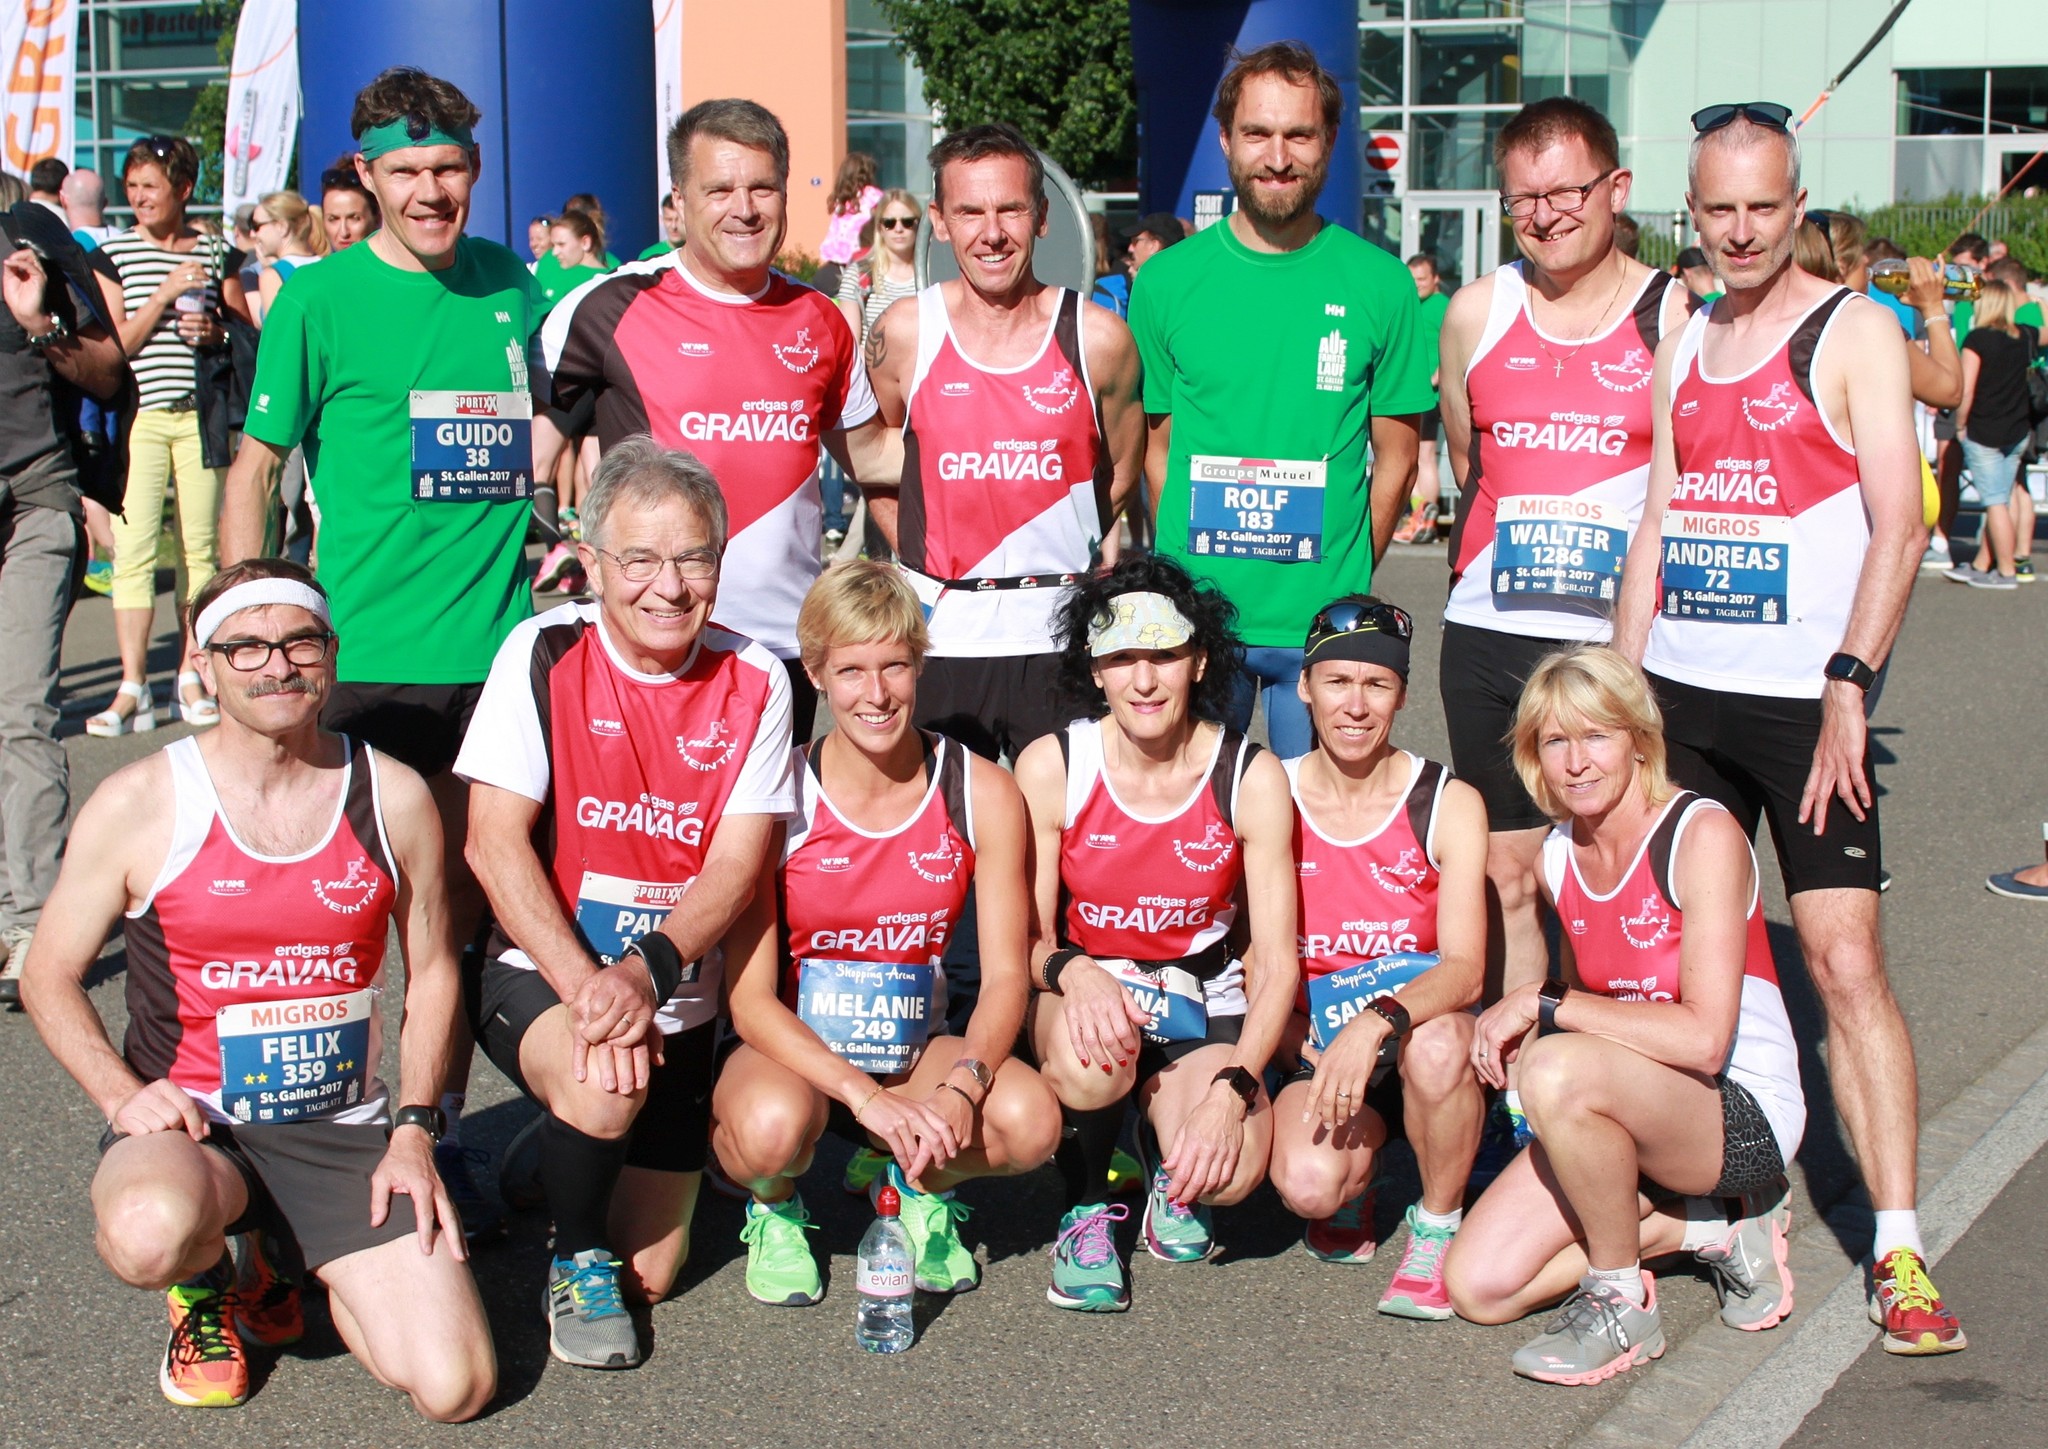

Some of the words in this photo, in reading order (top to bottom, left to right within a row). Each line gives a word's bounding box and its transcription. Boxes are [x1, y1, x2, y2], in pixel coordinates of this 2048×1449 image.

[1318, 328, 1347, 354] AUF
[1317, 361, 1346, 376] LAUF
[742, 400, 788, 412] erdgas
[680, 412, 810, 441] GRAVAG
[1550, 411, 1600, 424] erdgas
[436, 423, 513, 446] GUIDO
[1492, 421, 1628, 456] GRAVAG
[994, 438, 1037, 452] erdgas
[466, 448, 490, 467] 38
[938, 452, 1062, 480] GRAVAG
[1715, 457, 1752, 472] erdgas
[441, 470, 456, 482] St.
[456, 470, 488, 481] Gallen
[490, 471, 510, 482] 2017
[1204, 465, 1254, 480] Groupe
[1260, 469, 1312, 480] Mutuel
[478, 486, 511, 494] TAGBLATT
[1224, 487, 1288, 510] ROLF
[1520, 500, 1602, 520] MIGROS
[1237, 510, 1274, 530] 183
[1683, 516, 1760, 536] MIGROS
[1216, 530, 1230, 541] St.
[1231, 531, 1264, 543] Gallen
[1267, 534, 1292, 544] 2017
[1510, 524, 1609, 552] WALTER
[1252, 547, 1292, 556] TAGBLATT
[1532, 546, 1584, 566] 1286
[1666, 542, 1780, 570] ANDREAS
[1516, 568, 1530, 577] St.
[1532, 568, 1566, 578] Gallen
[1568, 570, 1594, 580] 2017
[1705, 570, 1730, 589] 72
[1552, 582, 1594, 593] TAGBLATT
[1682, 590, 1694, 600] St.
[1695, 592, 1727, 603] Gallen
[1729, 594, 1755, 604] 2017
[1714, 608, 1756, 618] TAGBLATT
[640, 792, 675, 811] egas
[576, 796, 704, 846] GRAVAG
[312, 877, 378, 914] RHEINTAL
[1138, 895, 1186, 908] erdgas
[878, 912, 927, 926] erdgas
[1078, 902, 1209, 933] GRAVAG
[1342, 919, 1388, 932] erdgas
[811, 922, 948, 952] GRAVAG
[275, 943, 330, 958] erdgas
[200, 957, 358, 989] GRAVAG
[835, 964, 883, 987] Shopping
[885, 966, 916, 981] Arena
[1331, 967, 1376, 988] Shopping
[1374, 959, 1408, 975] Arena
[1608, 978, 1640, 990] erdgas
[251, 1000, 348, 1028] MIGROS
[811, 992, 924, 1019] MELANIE
[851, 1020, 896, 1040] 249
[262, 1030, 341, 1064] FELIX
[830, 1042, 846, 1052] St.
[846, 1042, 885, 1054] Gallen
[887, 1045, 910, 1055] 2017
[282, 1060, 326, 1086] 359
[260, 1092, 278, 1104] St.
[279, 1087, 318, 1102] Gallen
[320, 1081, 342, 1095] 2017
[304, 1097, 342, 1113] TAGBLATT
[871, 1274, 908, 1286] evian
